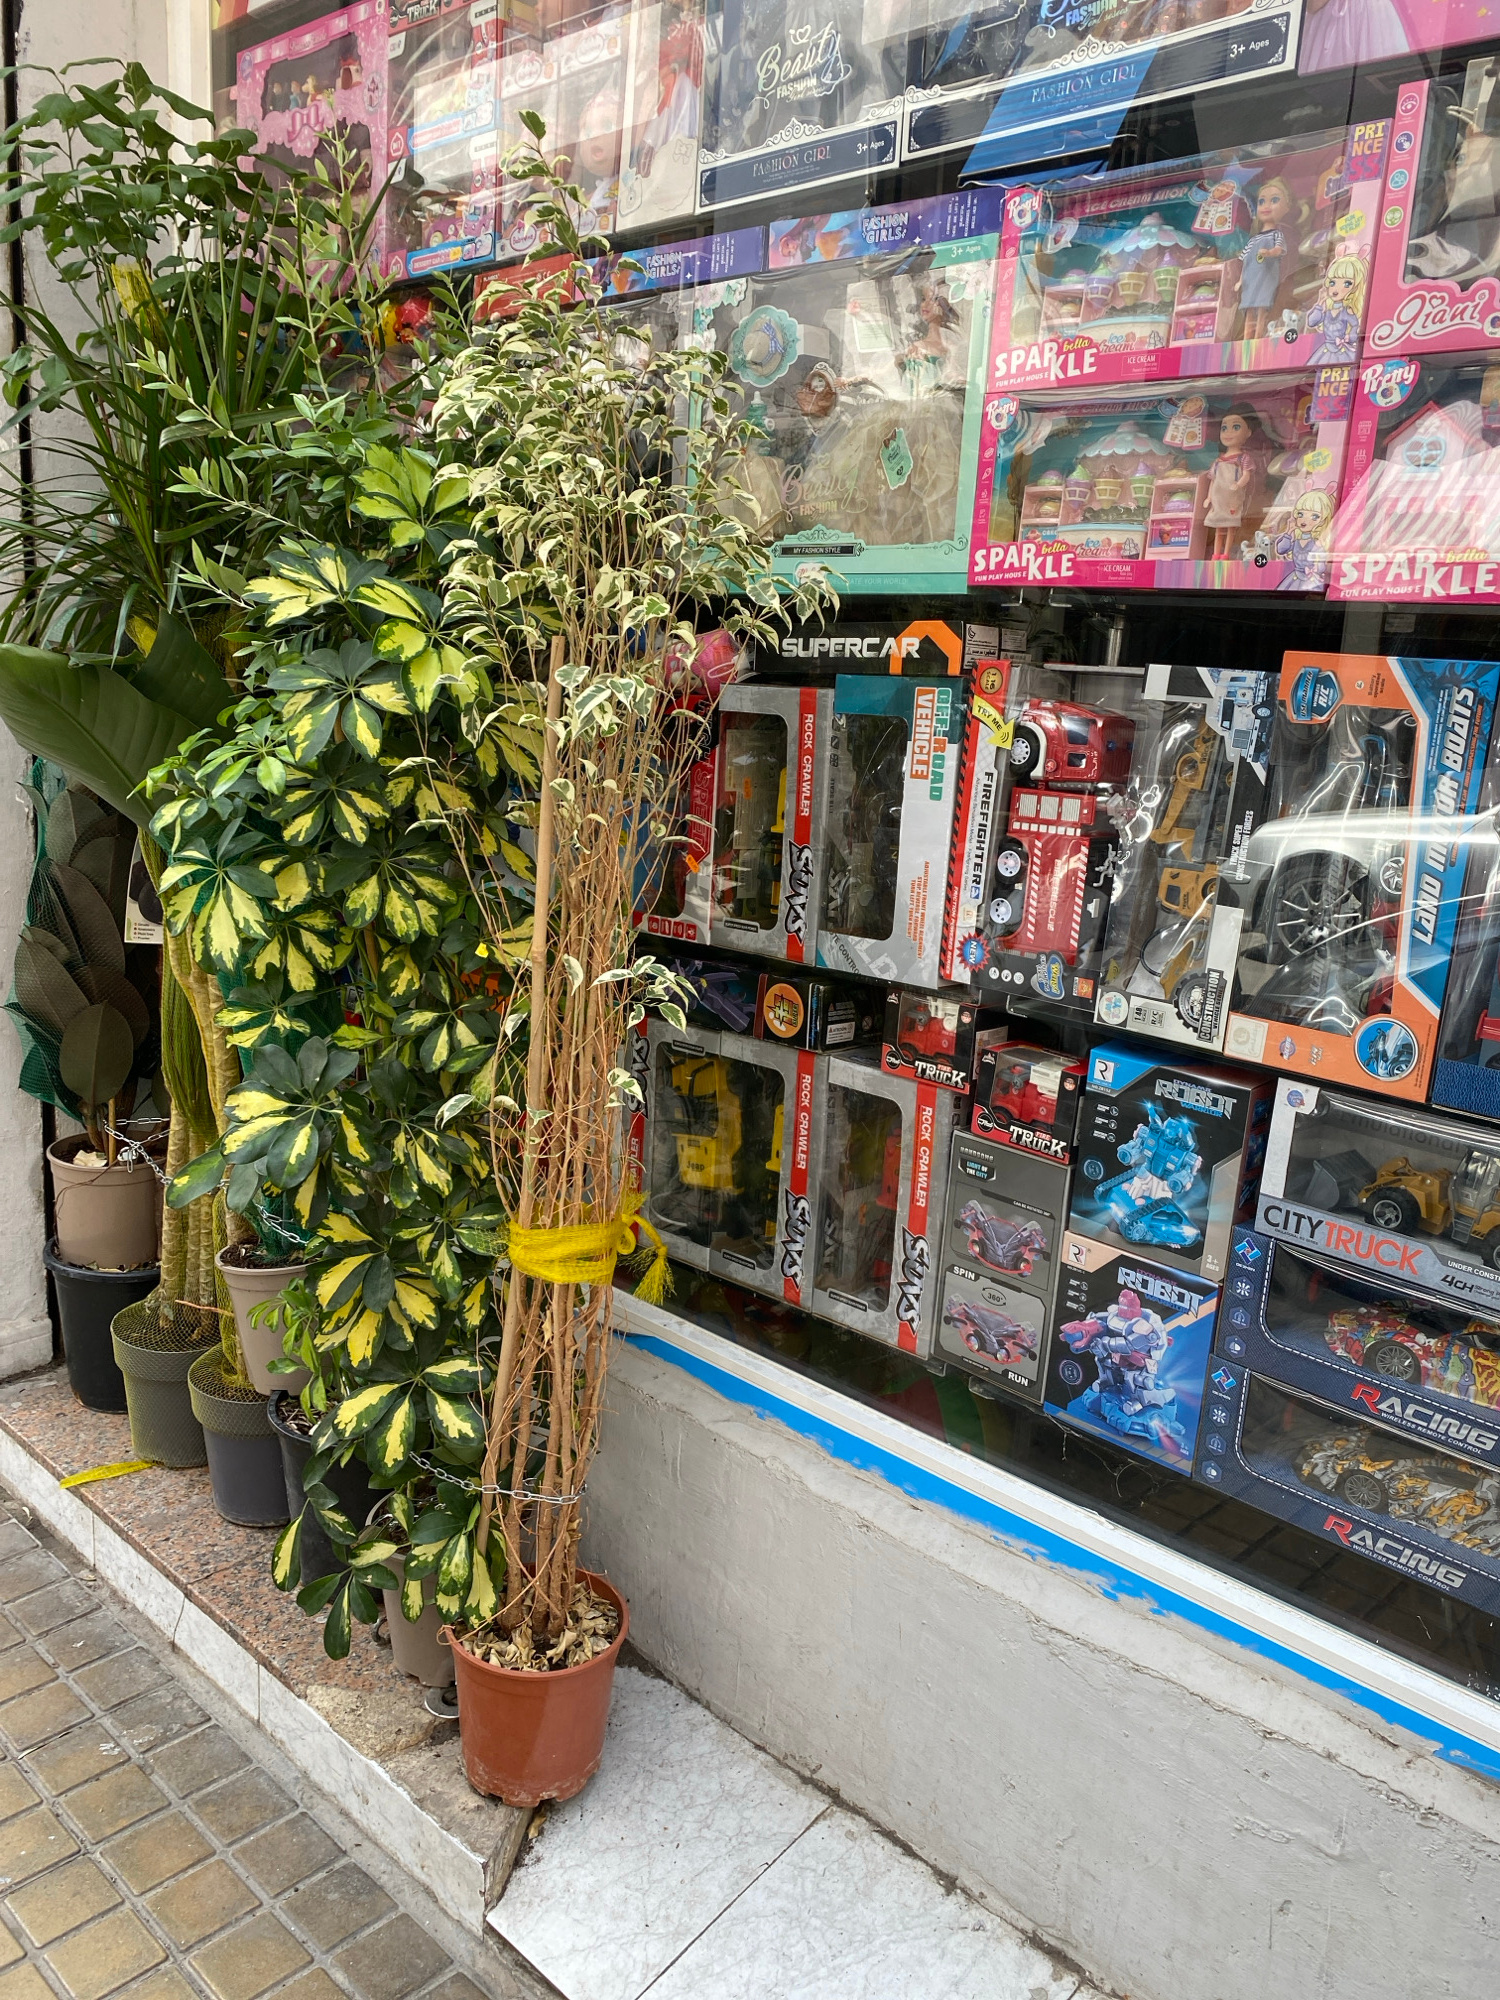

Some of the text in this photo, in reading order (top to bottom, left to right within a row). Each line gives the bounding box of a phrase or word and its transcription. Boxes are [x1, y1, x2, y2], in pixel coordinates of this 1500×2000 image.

[757, 21, 852, 93] Beauty
[1230, 39, 1270, 58] 3+ Ages
[777, 74, 816, 98] FASHION
[1032, 64, 1136, 103] FASHION GIRL
[1354, 121, 1386, 141] PRI
[856, 140, 885, 155] 3+ Ages
[1351, 137, 1383, 156] NCE
[753, 154, 799, 177] FASHION
[804, 146, 831, 164] GIRL
[1347, 154, 1380, 181] SS
[863, 212, 908, 243] FASHION GIRLS
[951, 244, 981, 258] 3+ Ages
[646, 251, 683, 279] FASHION GIRLS
[1063, 337, 1090, 352] bella
[1286, 331, 1298, 342] 3+
[1127, 354, 1156, 365] ICE CREAM
[996, 378, 1009, 387] FUN
[1010, 376, 1025, 385] PLAY
[1320, 367, 1351, 383] PRI
[1318, 381, 1349, 397] NCE
[1316, 396, 1346, 420] SS
[800, 500, 838, 516] FASHION
[802, 546, 824, 554] FASHION
[825, 546, 842, 554] STYLE
[1041, 542, 1068, 555] bella
[1113, 564, 1132, 573] CREAM
[1256, 556, 1268, 566] 3+
[975, 574, 987, 582] FUN
[988, 572, 1004, 581] PLAY
[1341, 588, 1360, 597] FUN
[1362, 587, 1384, 597] PLAY
[781, 637, 921, 659] SUPERCAR
[1318, 684, 1330, 708] R/C
[977, 704, 1003, 732] TRY ME
[1441, 687, 1475, 772] BOATS
[912, 692, 934, 779] VEHICLE
[929, 687, 952, 801] OFF-ROAD
[800, 713, 815, 817] ROCK CRAWLER
[971, 771, 994, 886] FIREFIGHTER
[1243, 810, 1254, 834] FORCES
[1233, 824, 1243, 845] SUPER
[951, 886, 959, 917] FRICTION
[947, 918, 956, 950] POWERED
[968, 940, 978, 964] NEW
[1200, 971, 1220, 1039] CONSTRUCTION
[1151, 1010, 1159, 1025] R/C
[1212, 1006, 1220, 1029] VEHICLE
[915, 1061, 966, 1089] TRUCK
[937, 1064, 952, 1072] FIRE
[1155, 1079, 1238, 1120] ROBOT
[796, 1073, 812, 1170] ROCK CRAWLER
[1009, 1126, 1067, 1160] TRUCK
[1035, 1131, 1051, 1140] FIRE
[686, 1160, 705, 1173] Jeep
[916, 1106, 933, 1208] ROCK CRAWLER
[966, 1168, 988, 1179] THE CITY
[1263, 1205, 1423, 1275] CITY TRUCK
[1205, 1262, 1219, 1272] AGES
[1206, 1254, 1219, 1265] 3+
[1448, 1260, 1472, 1272] UNDER
[953, 1266, 976, 1281] SPIN
[1440, 1274, 1494, 1296] 4CH Strong
[1117, 1266, 1203, 1319] ROBOT
[1008, 1371, 1029, 1387] RUN
[1351, 1383, 1499, 1451] RACING
[1381, 1412, 1482, 1454] WIRELESS REMOTE CONTROL
[1323, 1514, 1467, 1588] RACING
[1353, 1543, 1450, 1591] WIRELESS REMOTE CONTROL
